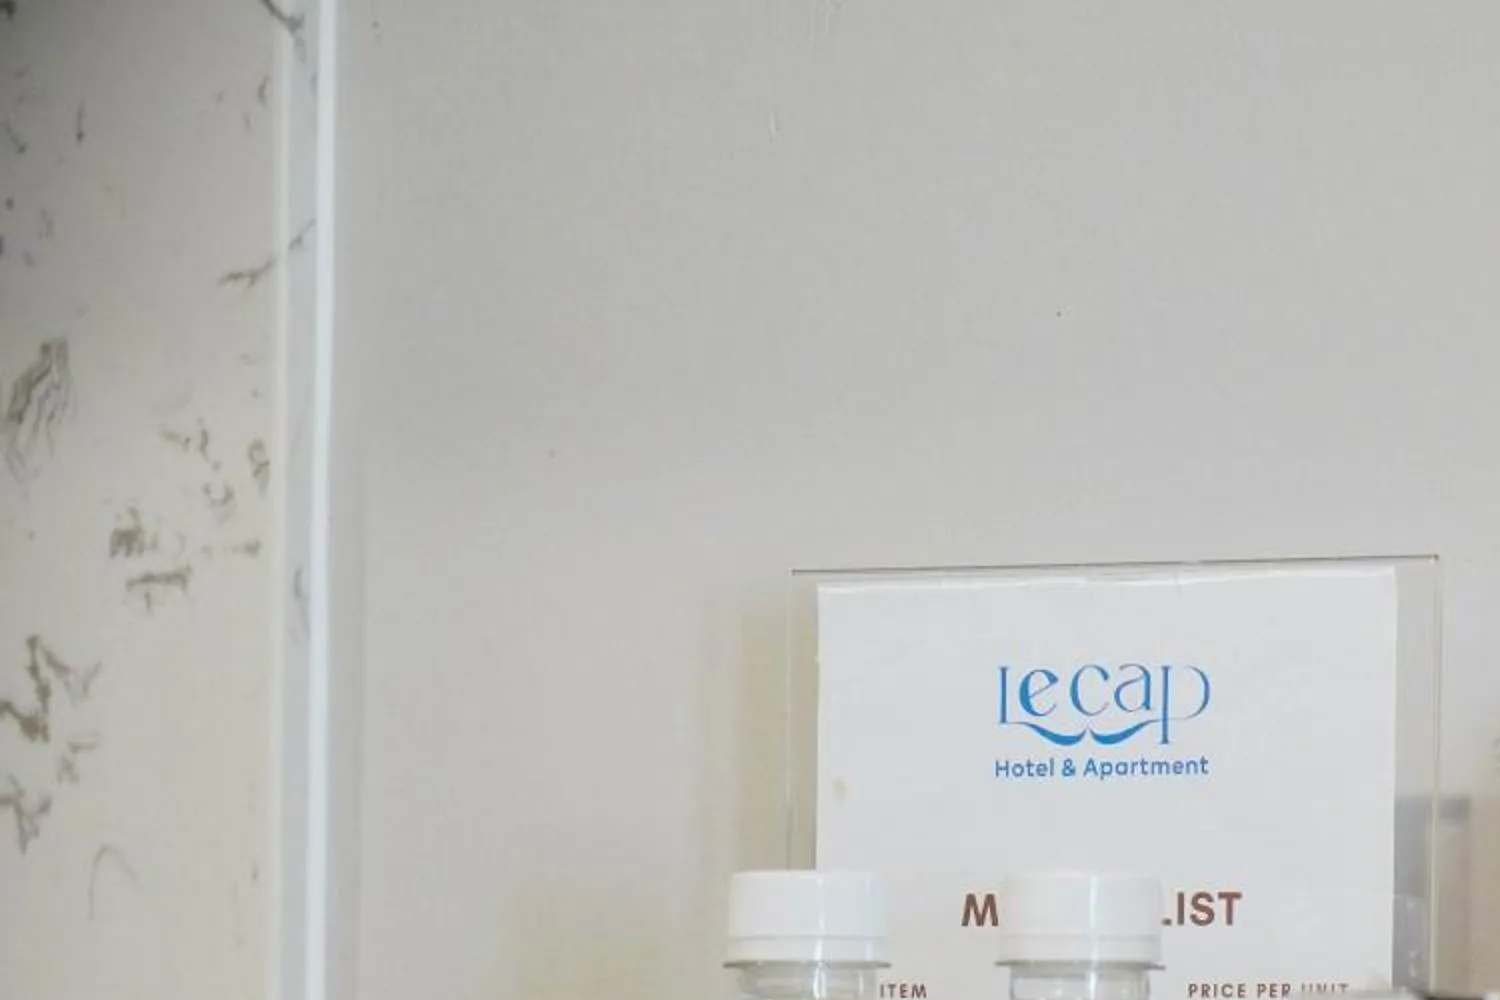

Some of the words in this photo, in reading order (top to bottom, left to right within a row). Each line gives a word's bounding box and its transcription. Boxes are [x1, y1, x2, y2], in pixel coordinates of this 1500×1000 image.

[994, 758, 1055, 778] Hotel
[1061, 758, 1076, 777] &
[1083, 756, 1210, 780] Apartment
[1161, 891, 1243, 927] IST
[879, 983, 928, 999] ITEM
[1187, 983, 1247, 999] PRICE
[1257, 983, 1292, 999] PER
